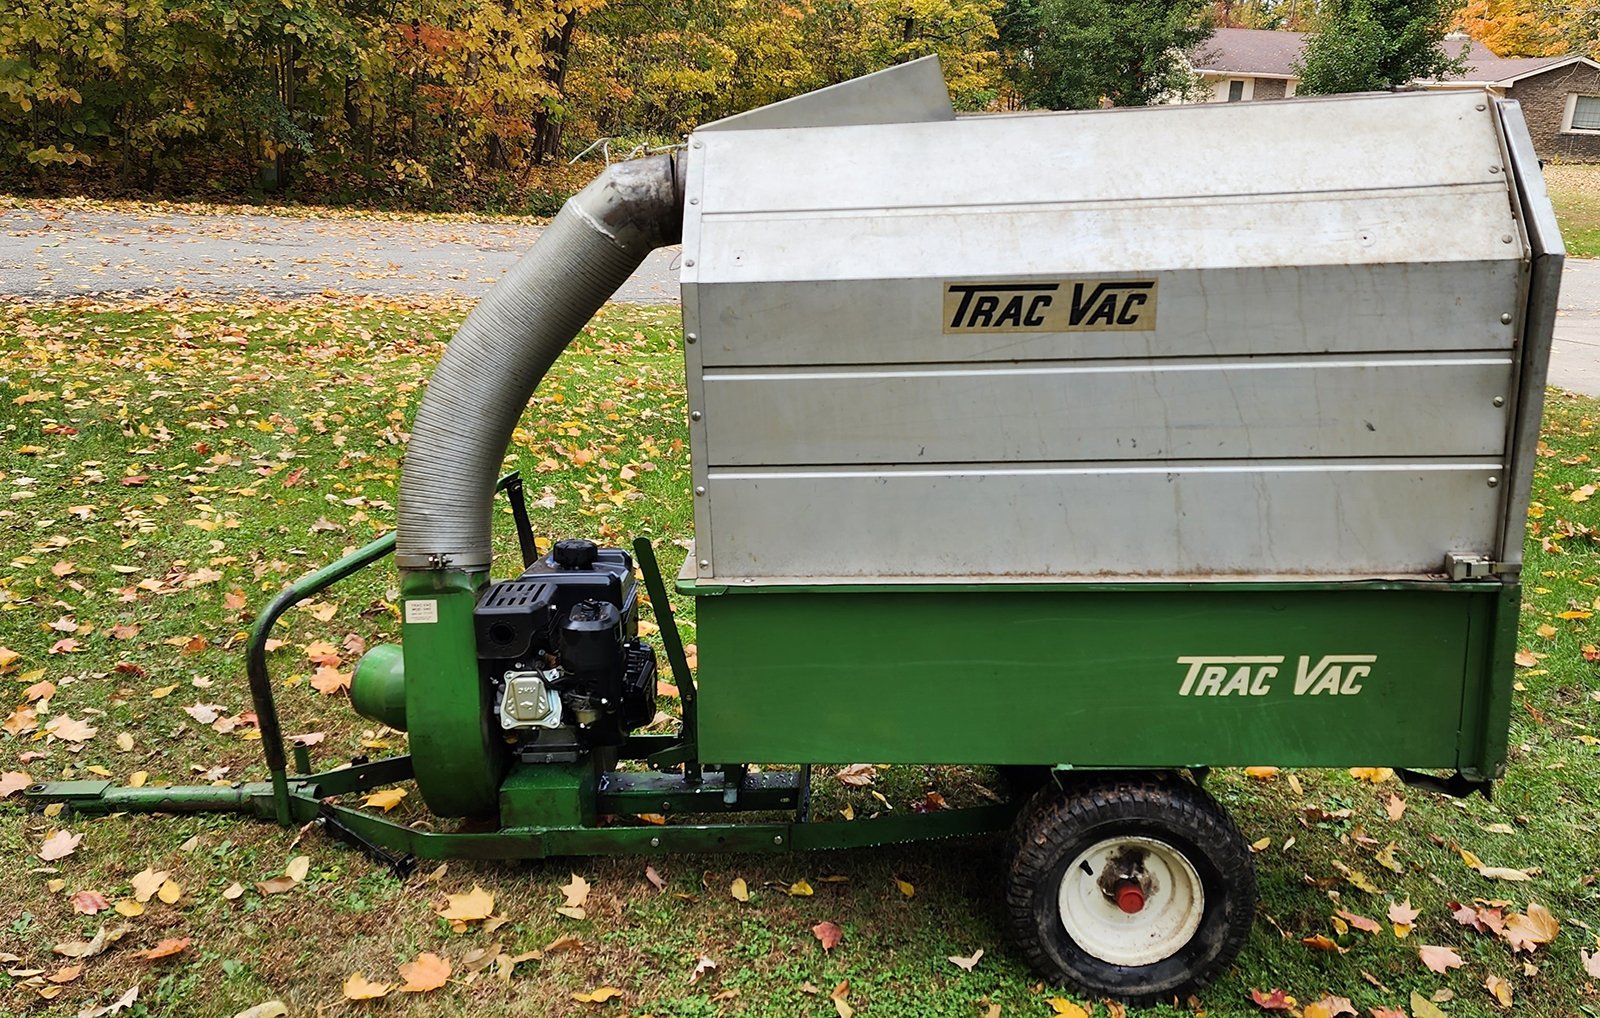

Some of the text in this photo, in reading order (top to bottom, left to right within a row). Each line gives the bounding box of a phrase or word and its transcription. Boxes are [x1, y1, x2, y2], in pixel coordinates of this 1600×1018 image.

[948, 281, 1155, 328] TRAC VAC
[1176, 655, 1378, 697] TRAC VAC
